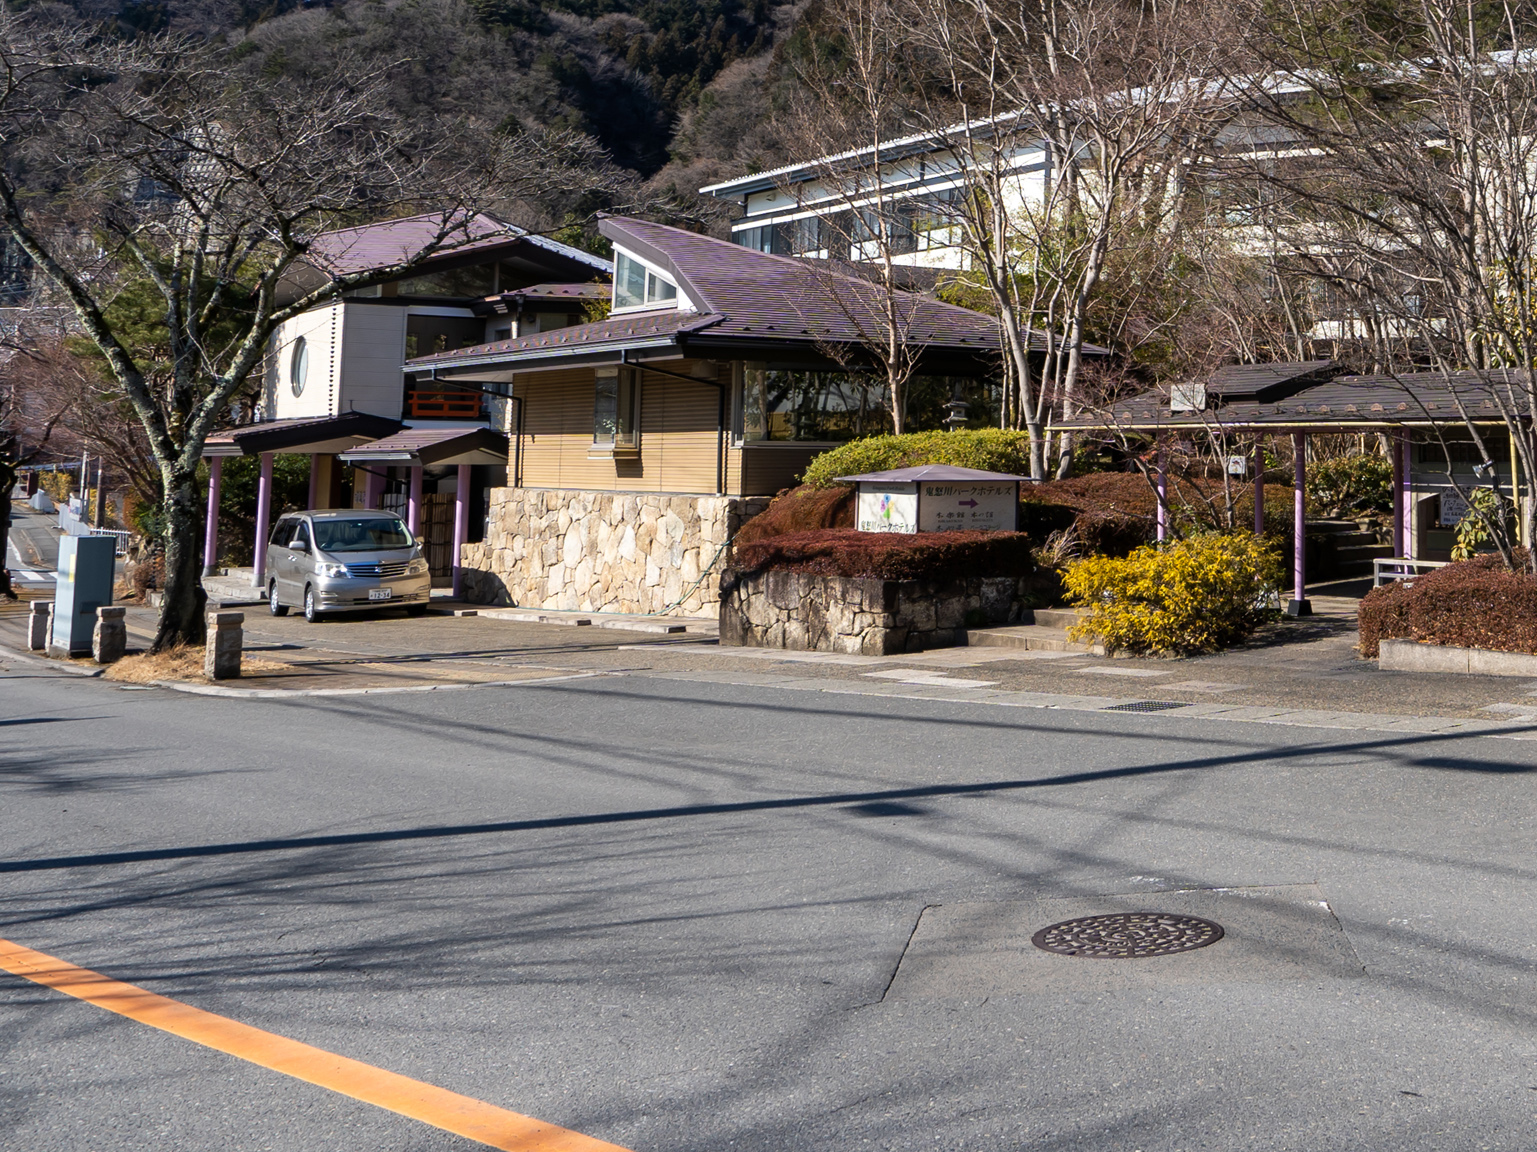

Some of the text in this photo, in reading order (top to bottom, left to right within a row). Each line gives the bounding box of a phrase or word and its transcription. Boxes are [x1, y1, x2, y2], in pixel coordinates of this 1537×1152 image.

[925, 486, 1013, 496] 鬼怒川パークホテルズ
